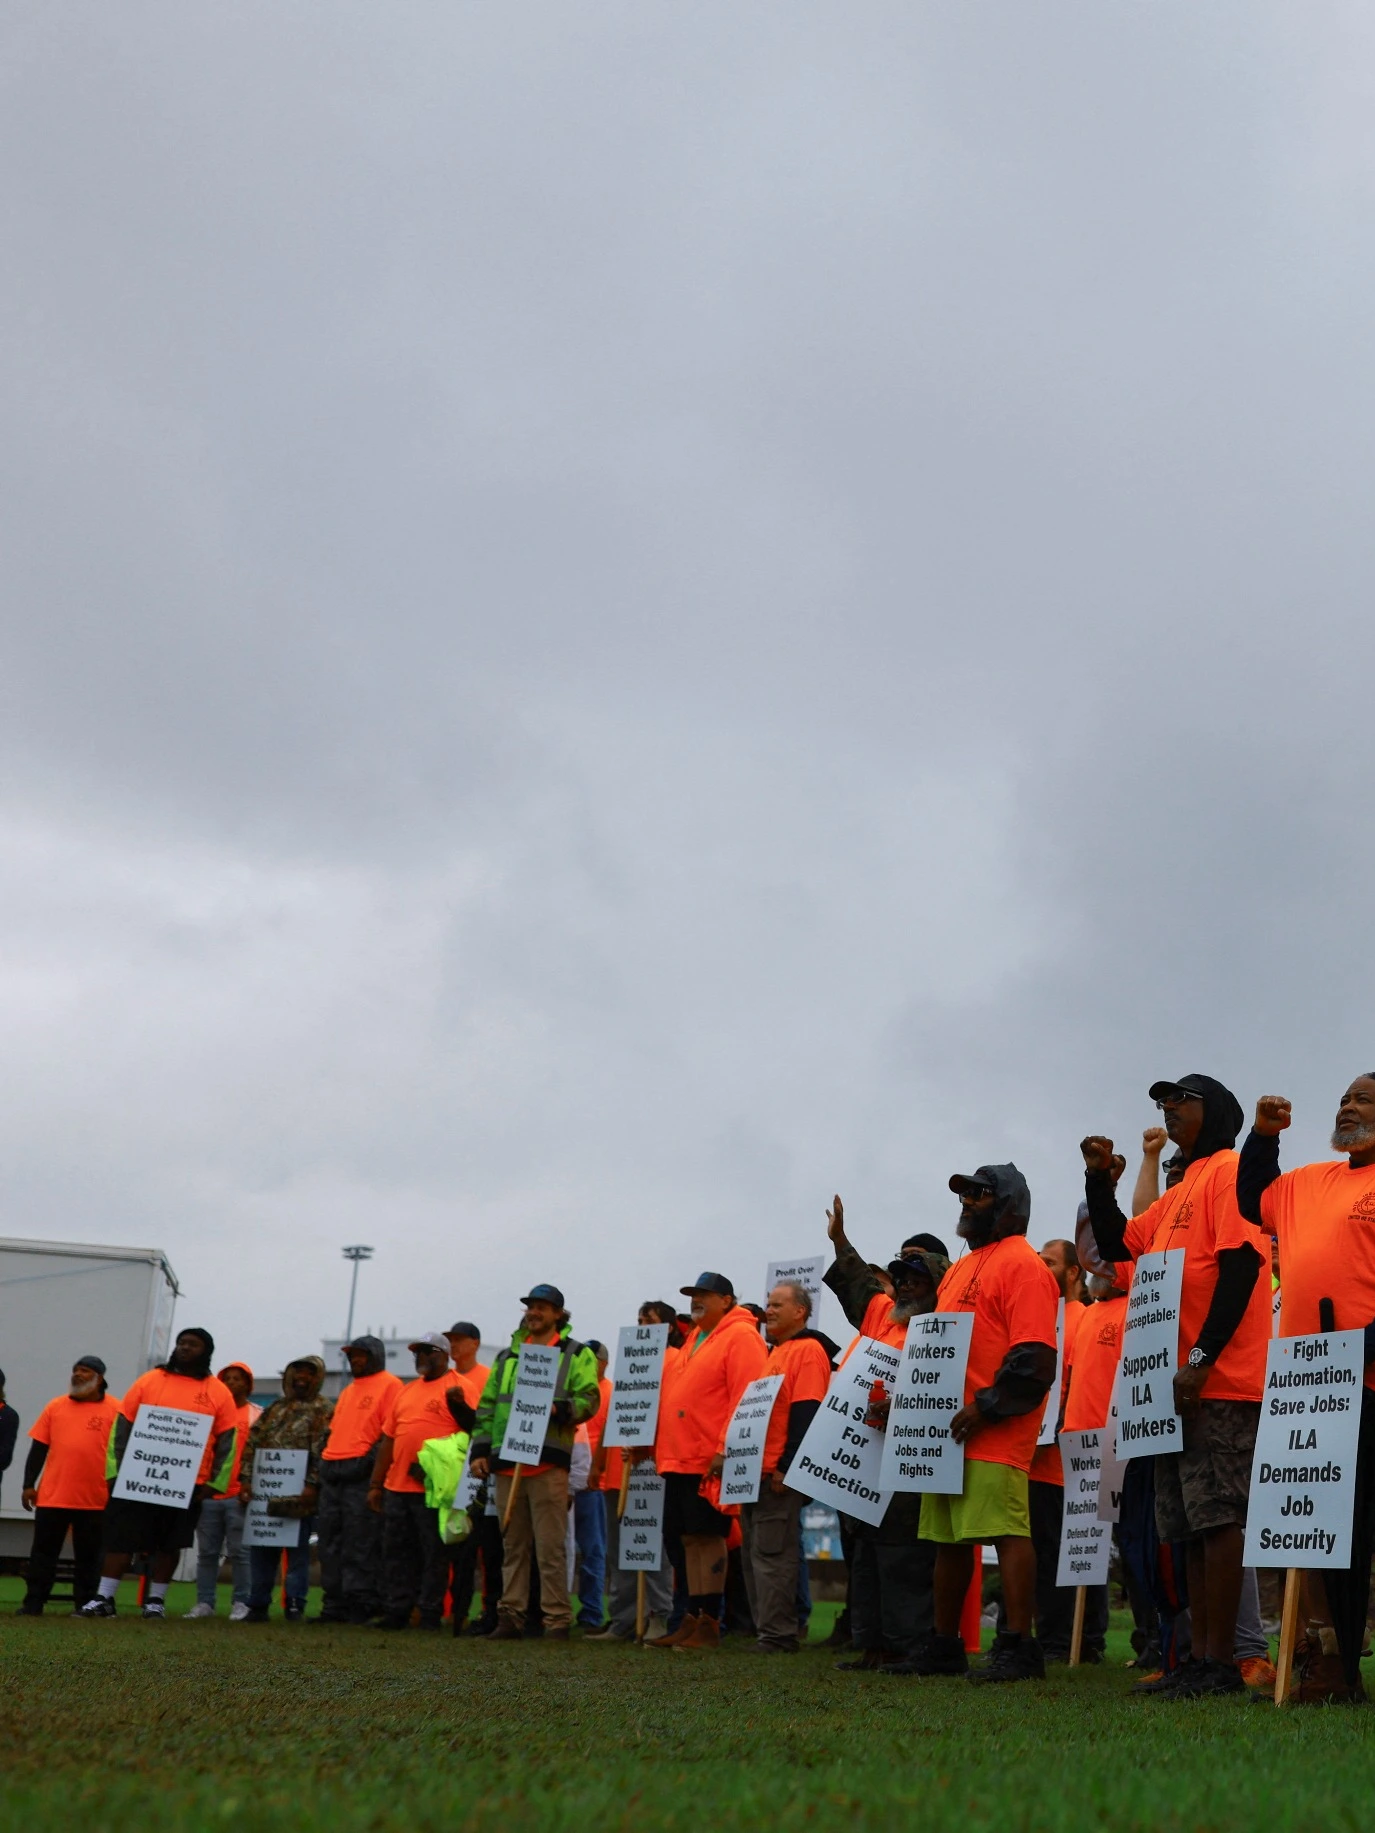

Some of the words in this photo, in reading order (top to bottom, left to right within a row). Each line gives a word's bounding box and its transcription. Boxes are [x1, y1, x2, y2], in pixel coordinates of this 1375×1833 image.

[776, 1268, 796, 1277] Profit
[1142, 1269, 1166, 1284] Over
[1151, 1289, 1160, 1302] is
[922, 1318, 940, 1334] ILA
[637, 1329, 650, 1340] ILA
[624, 1347, 658, 1357] Workers
[864, 1346, 900, 1368] Automa
[908, 1344, 955, 1360] Workers
[1294, 1340, 1328, 1362] Fight
[630, 1363, 649, 1374] Over
[1123, 1348, 1168, 1378] Support
[868, 1364, 896, 1383] Hurts
[912, 1368, 940, 1384] Over
[1268, 1366, 1356, 1389] Automation,
[615, 1380, 659, 1392] Machines:
[894, 1393, 958, 1410] Machines:
[1132, 1384, 1152, 1406] ILA
[516, 1400, 547, 1416] Support
[615, 1401, 638, 1410] Defend
[640, 1401, 651, 1409] Our
[827, 1395, 848, 1416] ILA
[1270, 1398, 1305, 1416] Save
[1310, 1394, 1349, 1412] Jobs:
[148, 1413, 172, 1424] Profit
[176, 1417, 198, 1427] Over
[617, 1414, 632, 1423] Jobs
[634, 1413, 646, 1422] and
[735, 1411, 748, 1421] Save
[148, 1423, 180, 1433] People
[520, 1420, 532, 1433] ILA
[619, 1427, 639, 1437] Rights
[739, 1427, 751, 1439] ILA
[894, 1425, 925, 1438] Defend
[929, 1426, 949, 1438] Our
[1122, 1418, 1176, 1441] Workers
[134, 1431, 203, 1448] Unacceptable:
[842, 1426, 869, 1448] For
[1081, 1434, 1098, 1449] ILA
[1288, 1429, 1317, 1450] ILA
[508, 1437, 539, 1454] Workers
[727, 1445, 759, 1458] Demands
[895, 1444, 918, 1456] Jobs
[921, 1445, 942, 1457] and
[134, 1449, 191, 1468] Support
[832, 1448, 861, 1470] Job
[1071, 1458, 1100, 1471] Worke
[146, 1468, 170, 1480] ILA
[734, 1463, 746, 1476] Job
[900, 1463, 934, 1478] Rights
[1260, 1462, 1341, 1483] Demands
[260, 1479, 282, 1488] Over
[799, 1456, 881, 1504] Protection
[1080, 1478, 1099, 1492] Over
[126, 1480, 186, 1499] Workers
[726, 1481, 754, 1495] Security
[635, 1499, 647, 1510] ILA
[1067, 1500, 1097, 1515] Machin
[1281, 1495, 1314, 1516] Job
[624, 1516, 657, 1527] Demands
[633, 1533, 647, 1544] Job
[1067, 1528, 1088, 1539] Defend
[1090, 1527, 1103, 1538] Our
[1260, 1528, 1336, 1554] Security
[625, 1549, 655, 1563] Security
[1068, 1544, 1082, 1555] Jobs
[1084, 1543, 1098, 1554] and
[1070, 1561, 1091, 1573] Rights
